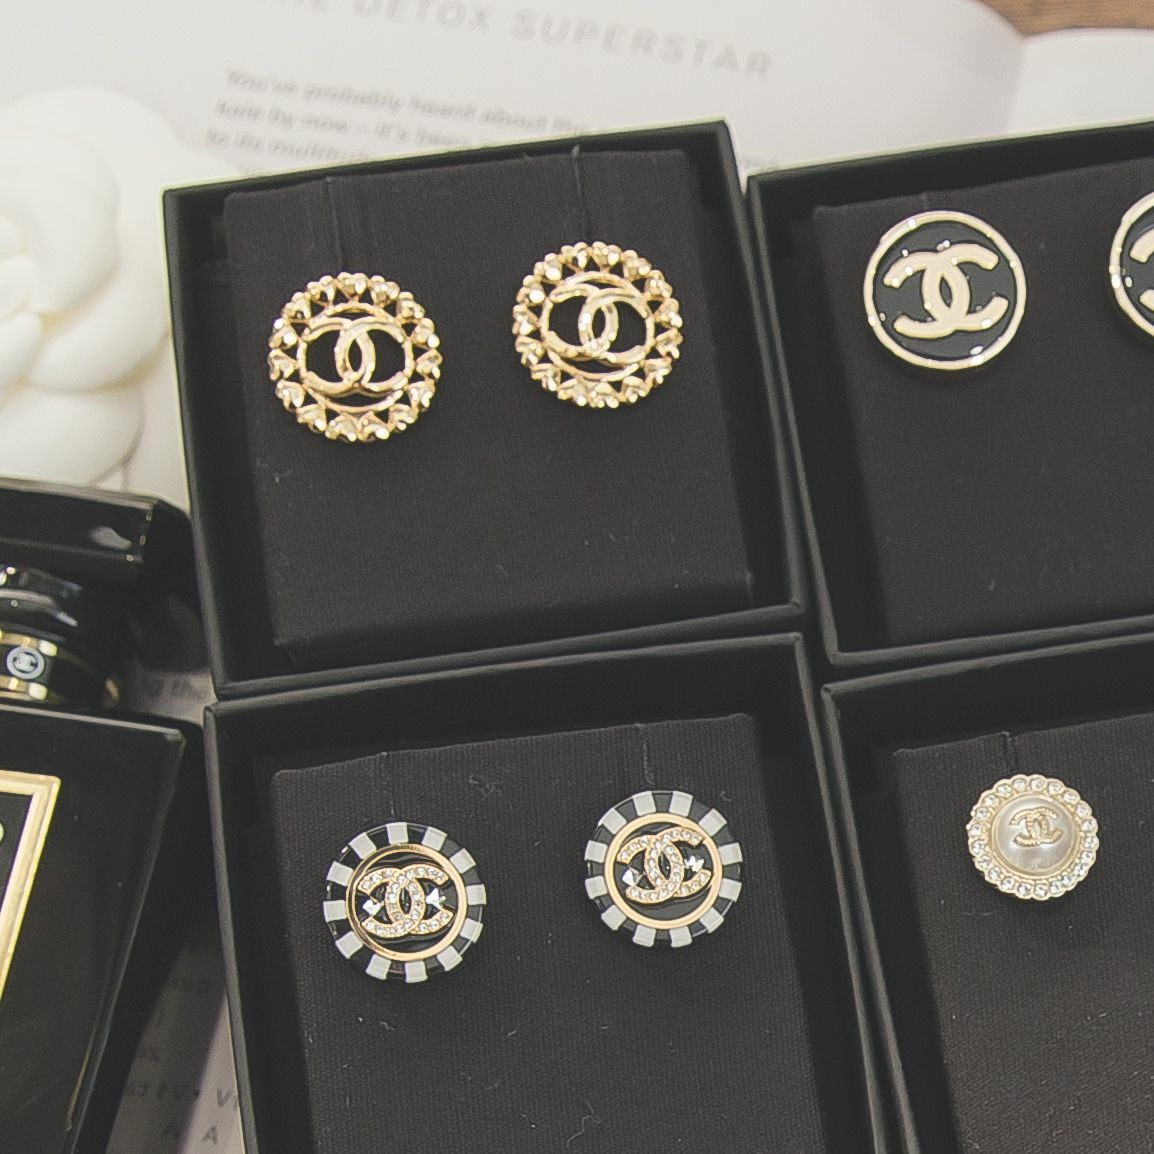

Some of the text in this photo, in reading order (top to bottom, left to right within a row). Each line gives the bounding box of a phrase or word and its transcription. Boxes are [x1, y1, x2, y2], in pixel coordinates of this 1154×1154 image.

[509, 11, 774, 82] SUPERSTAR
[302, 82, 404, 113] probably
[409, 95, 478, 121] heard
[300, 114, 352, 134] now
[201, 1125, 219, 1145] A
